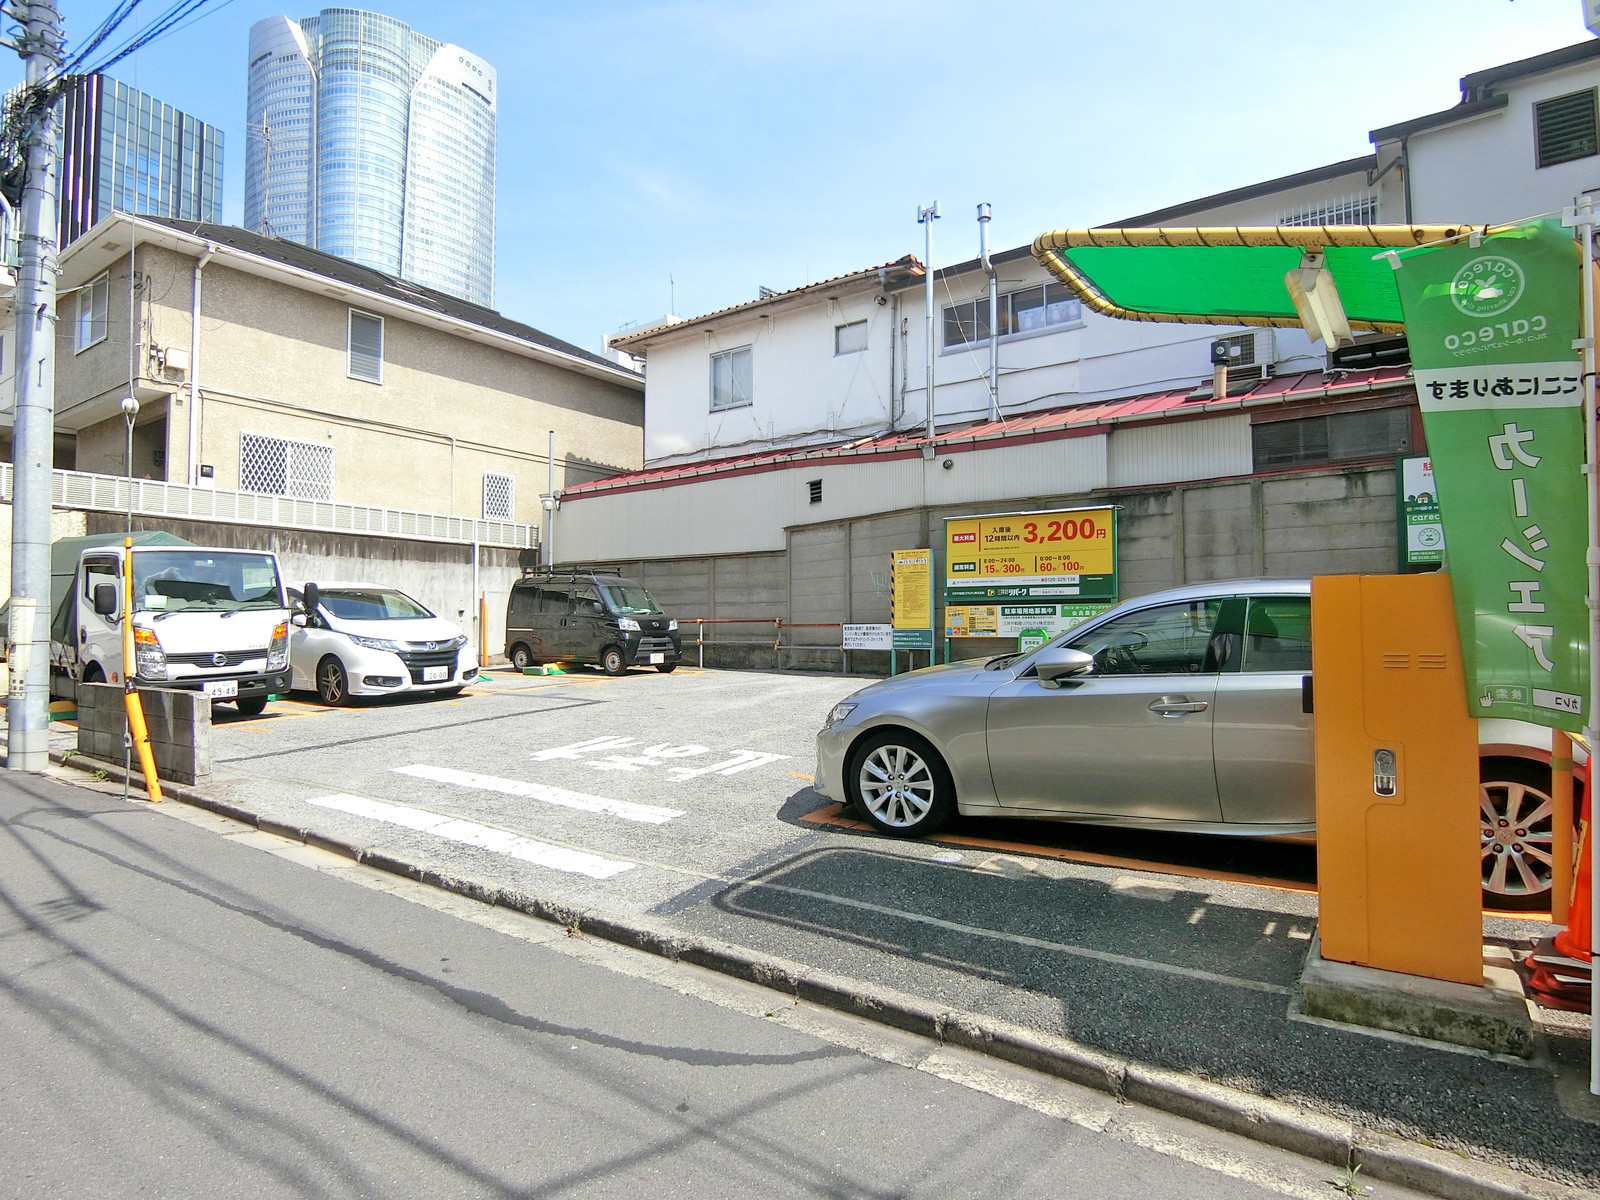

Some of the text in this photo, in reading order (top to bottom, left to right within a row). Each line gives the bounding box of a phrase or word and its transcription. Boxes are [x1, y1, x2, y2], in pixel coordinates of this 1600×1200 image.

[1412, 513, 1441, 522] carec
[992, 526, 1011, 534] 入庫後
[985, 534, 1020, 543] 12時間以内
[997, 588, 1027, 596] 三井のリパーク
[211, 686, 236, 696] 49-48
